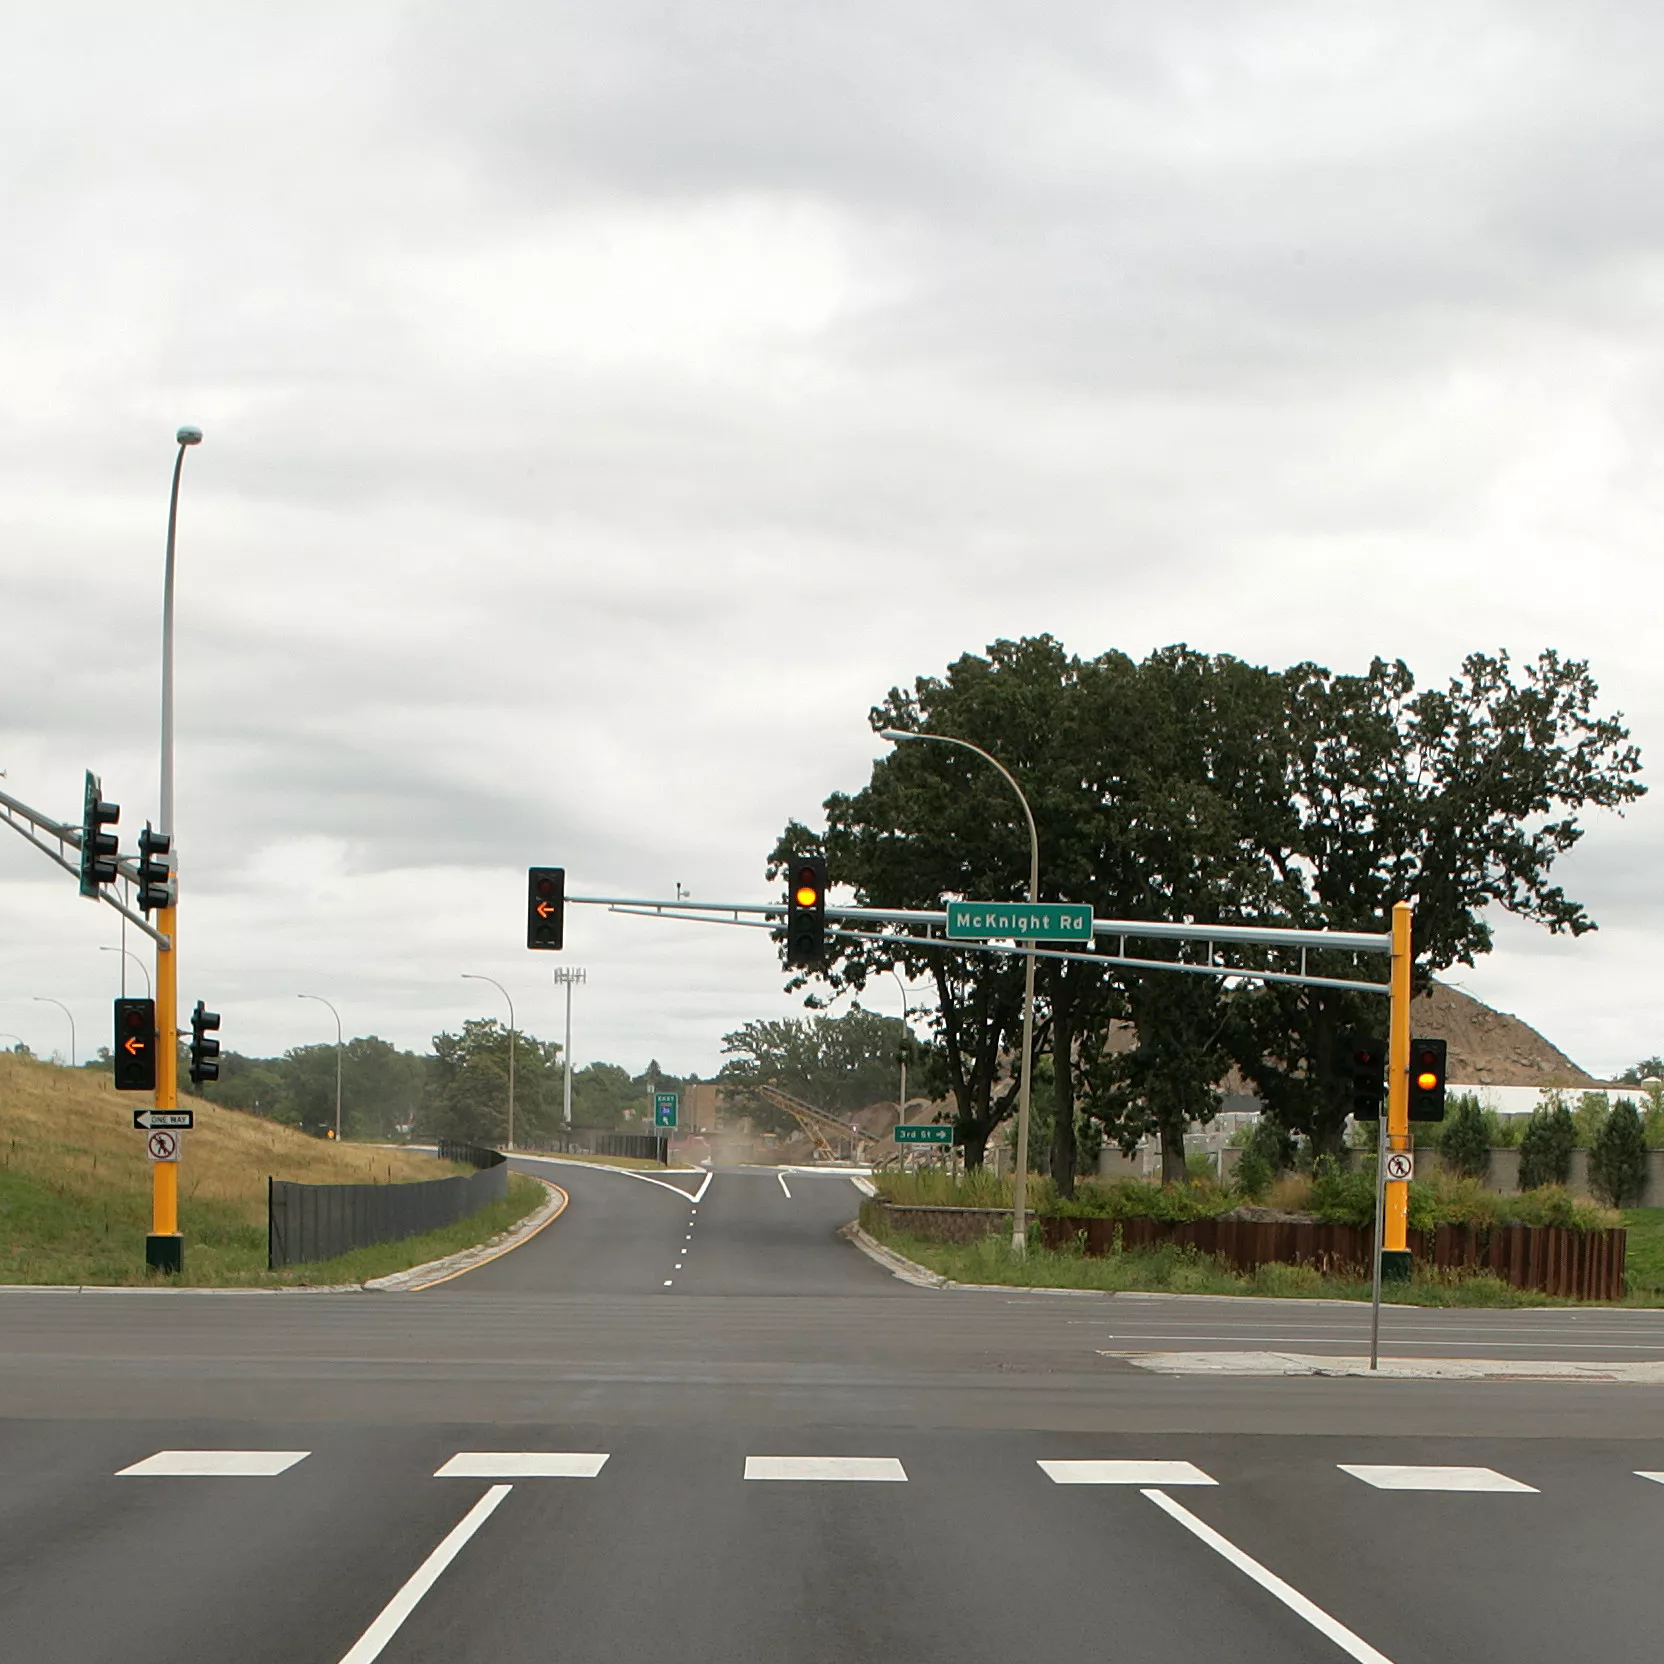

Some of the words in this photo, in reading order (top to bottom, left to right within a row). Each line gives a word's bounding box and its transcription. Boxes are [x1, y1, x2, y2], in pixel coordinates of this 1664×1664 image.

[957, 913, 1050, 933] McKnight
[1060, 914, 1083, 930] Rd
[900, 1130, 916, 1138] 3rd
[921, 1130, 931, 1139] St
